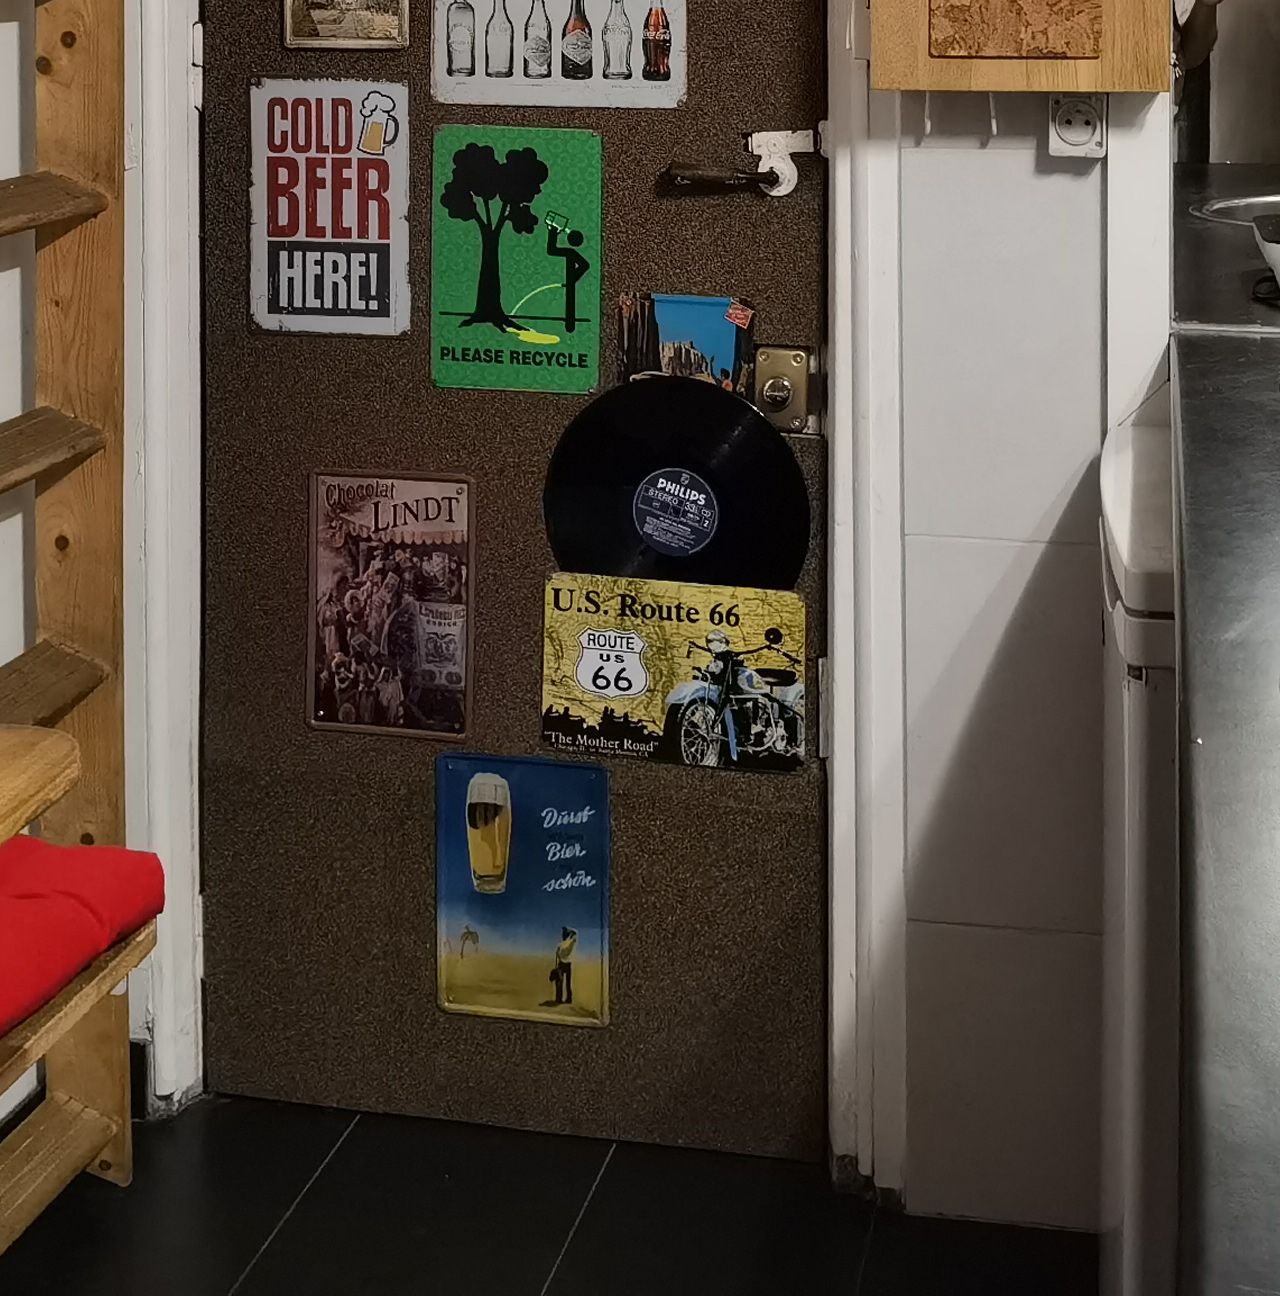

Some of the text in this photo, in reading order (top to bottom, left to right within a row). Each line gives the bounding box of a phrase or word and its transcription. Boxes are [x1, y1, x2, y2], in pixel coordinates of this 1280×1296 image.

[267, 97, 353, 154] COLD
[267, 156, 390, 240] BEER
[278, 251, 378, 311] HERE!
[440, 346, 588, 369] PLEASE RECYCLE
[325, 480, 396, 507] Chocolat
[657, 477, 707, 505] PHILIPS
[371, 496, 459, 533] LINDT
[551, 587, 740, 627] U.S. Route 66
[587, 632, 635, 651] ROUTE
[599, 653, 625, 664] US
[591, 665, 633, 692] 66
[576, 734, 621, 749] Mother
[545, 841, 587, 861] Bier
